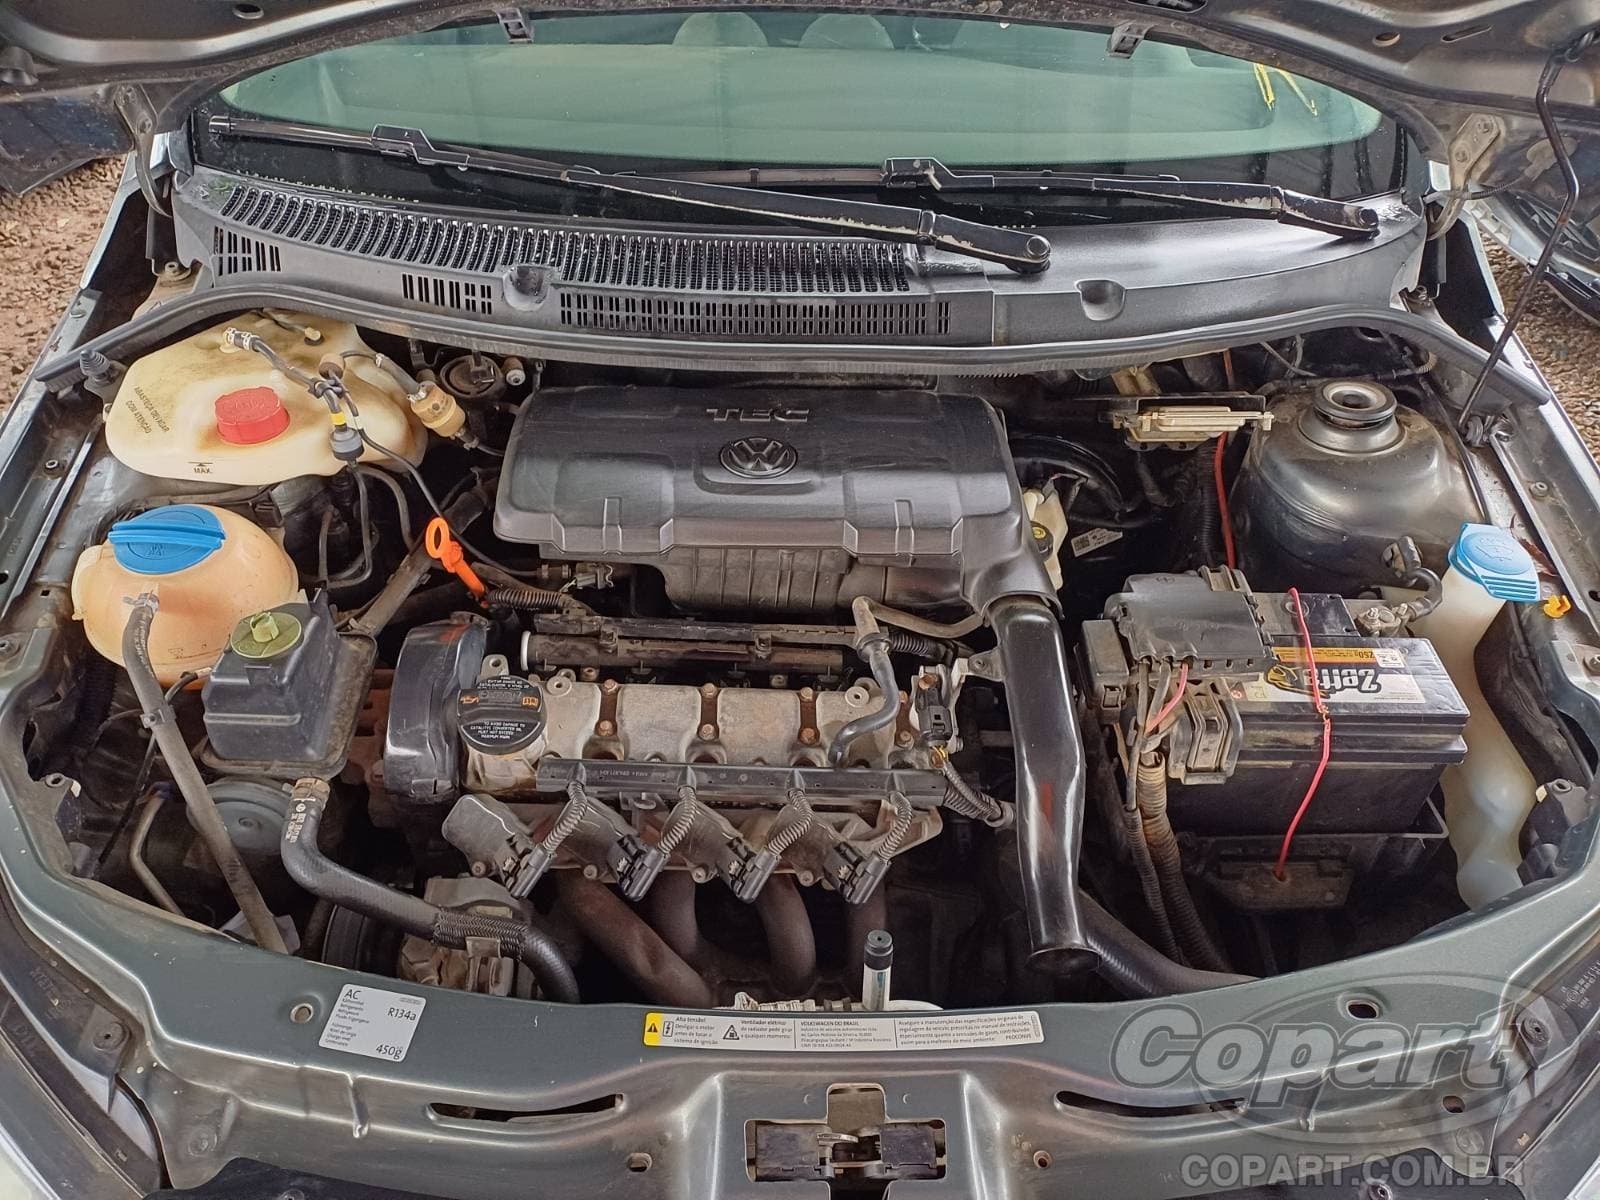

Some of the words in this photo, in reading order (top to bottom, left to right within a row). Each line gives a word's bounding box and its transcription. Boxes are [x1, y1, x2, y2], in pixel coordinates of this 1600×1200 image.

[706, 408, 810, 422] TEC
[344, 988, 362, 1000] AC
[387, 1007, 417, 1021] R134a
[376, 1044, 402, 1059] 450g
